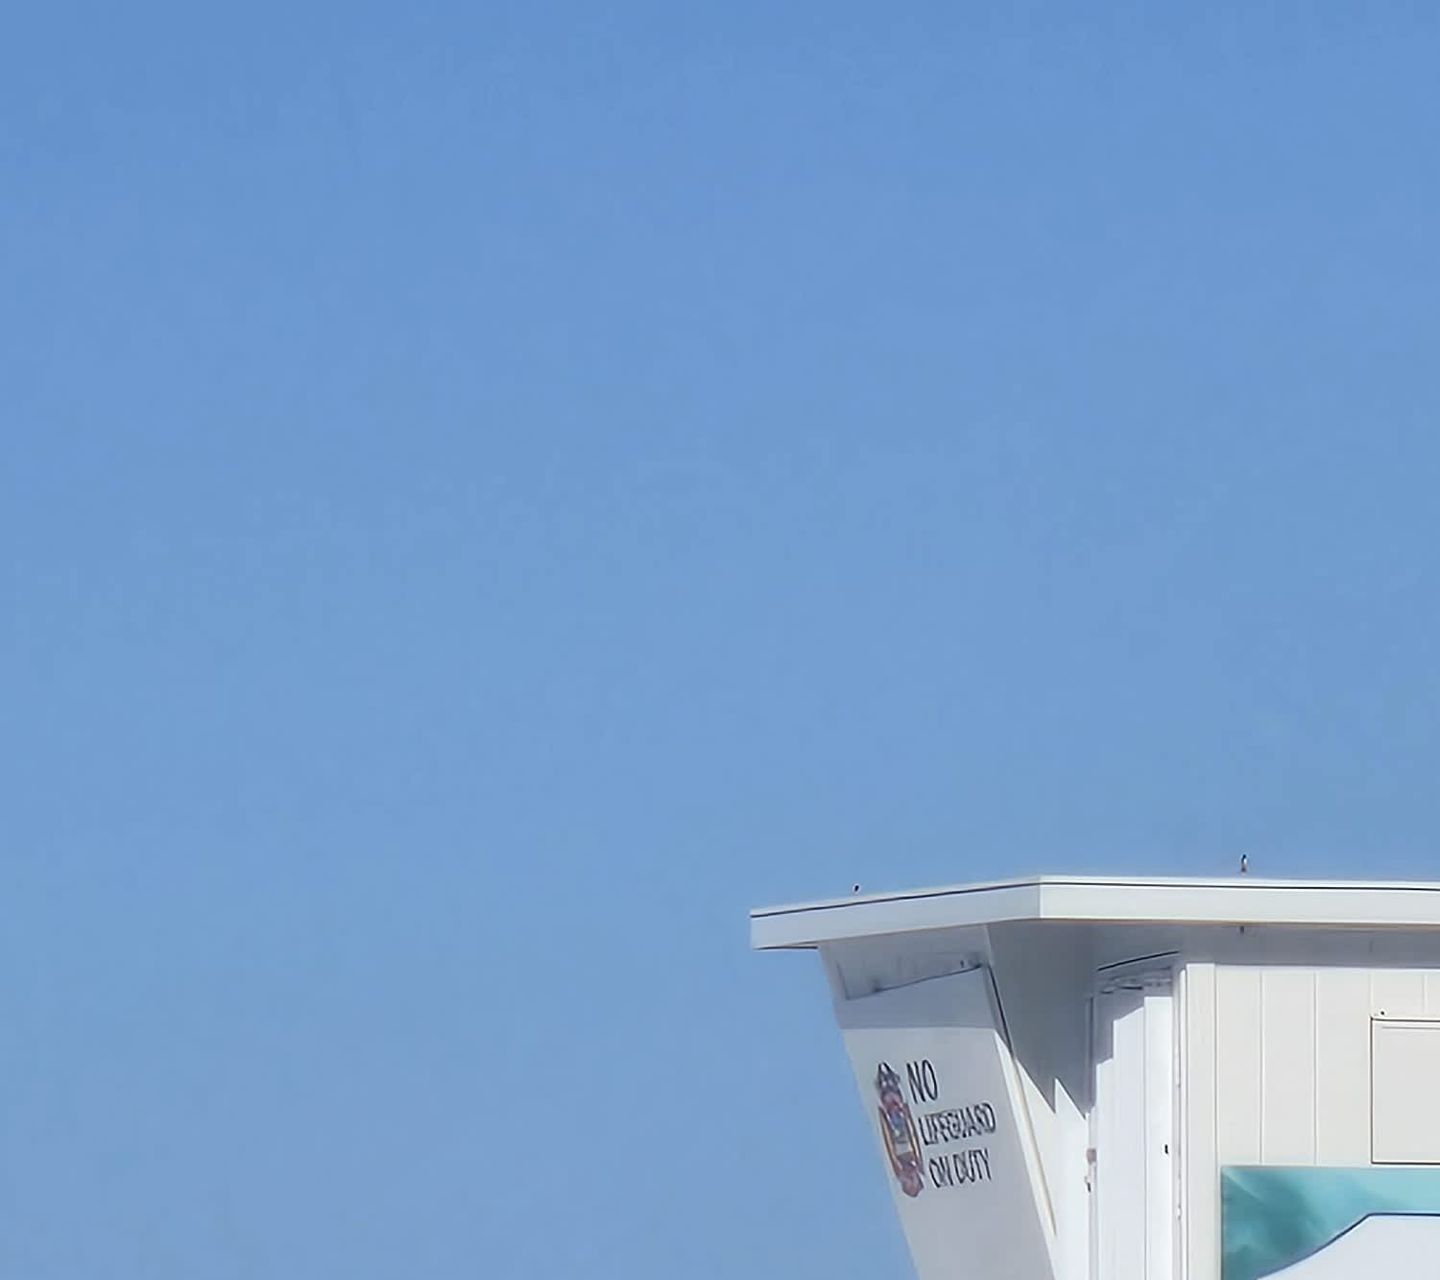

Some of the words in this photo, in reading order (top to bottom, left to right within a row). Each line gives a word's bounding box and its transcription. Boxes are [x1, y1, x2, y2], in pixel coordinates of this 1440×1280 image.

[906, 1059, 938, 1103] NO
[918, 1103, 996, 1145] LIFEGUARD
[929, 1156, 954, 1188] ON
[952, 1148, 991, 1184] DUTY
